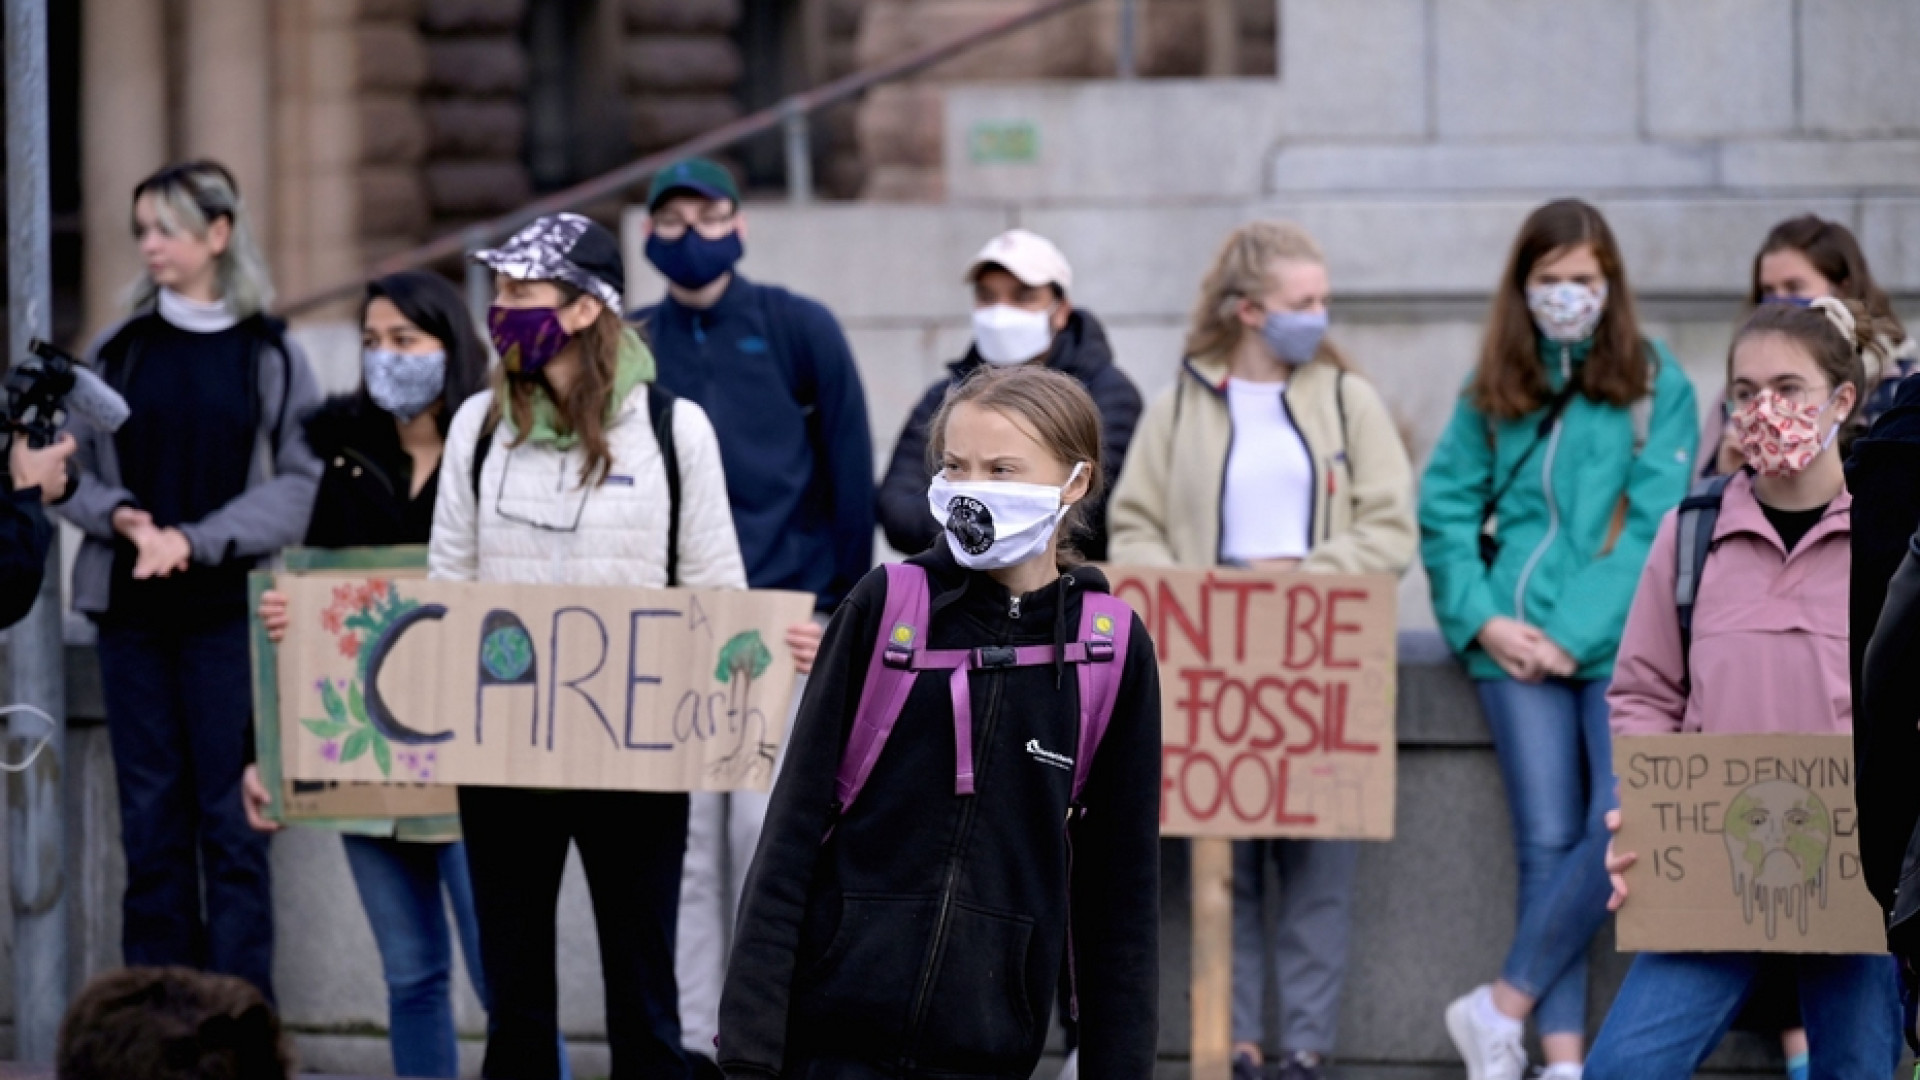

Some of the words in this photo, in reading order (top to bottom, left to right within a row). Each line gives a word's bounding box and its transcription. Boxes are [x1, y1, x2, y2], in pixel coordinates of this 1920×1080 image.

[1282, 584, 1369, 670] BE
[364, 603, 683, 752] CARE
[1176, 668, 1379, 755] FOSSIL
[1160, 745, 1318, 826] FOOL
[1628, 752, 1709, 791] STOP
[1723, 756, 1849, 788] DENYIN
[1651, 801, 1725, 834] THE
[1653, 846, 1685, 882] IS
